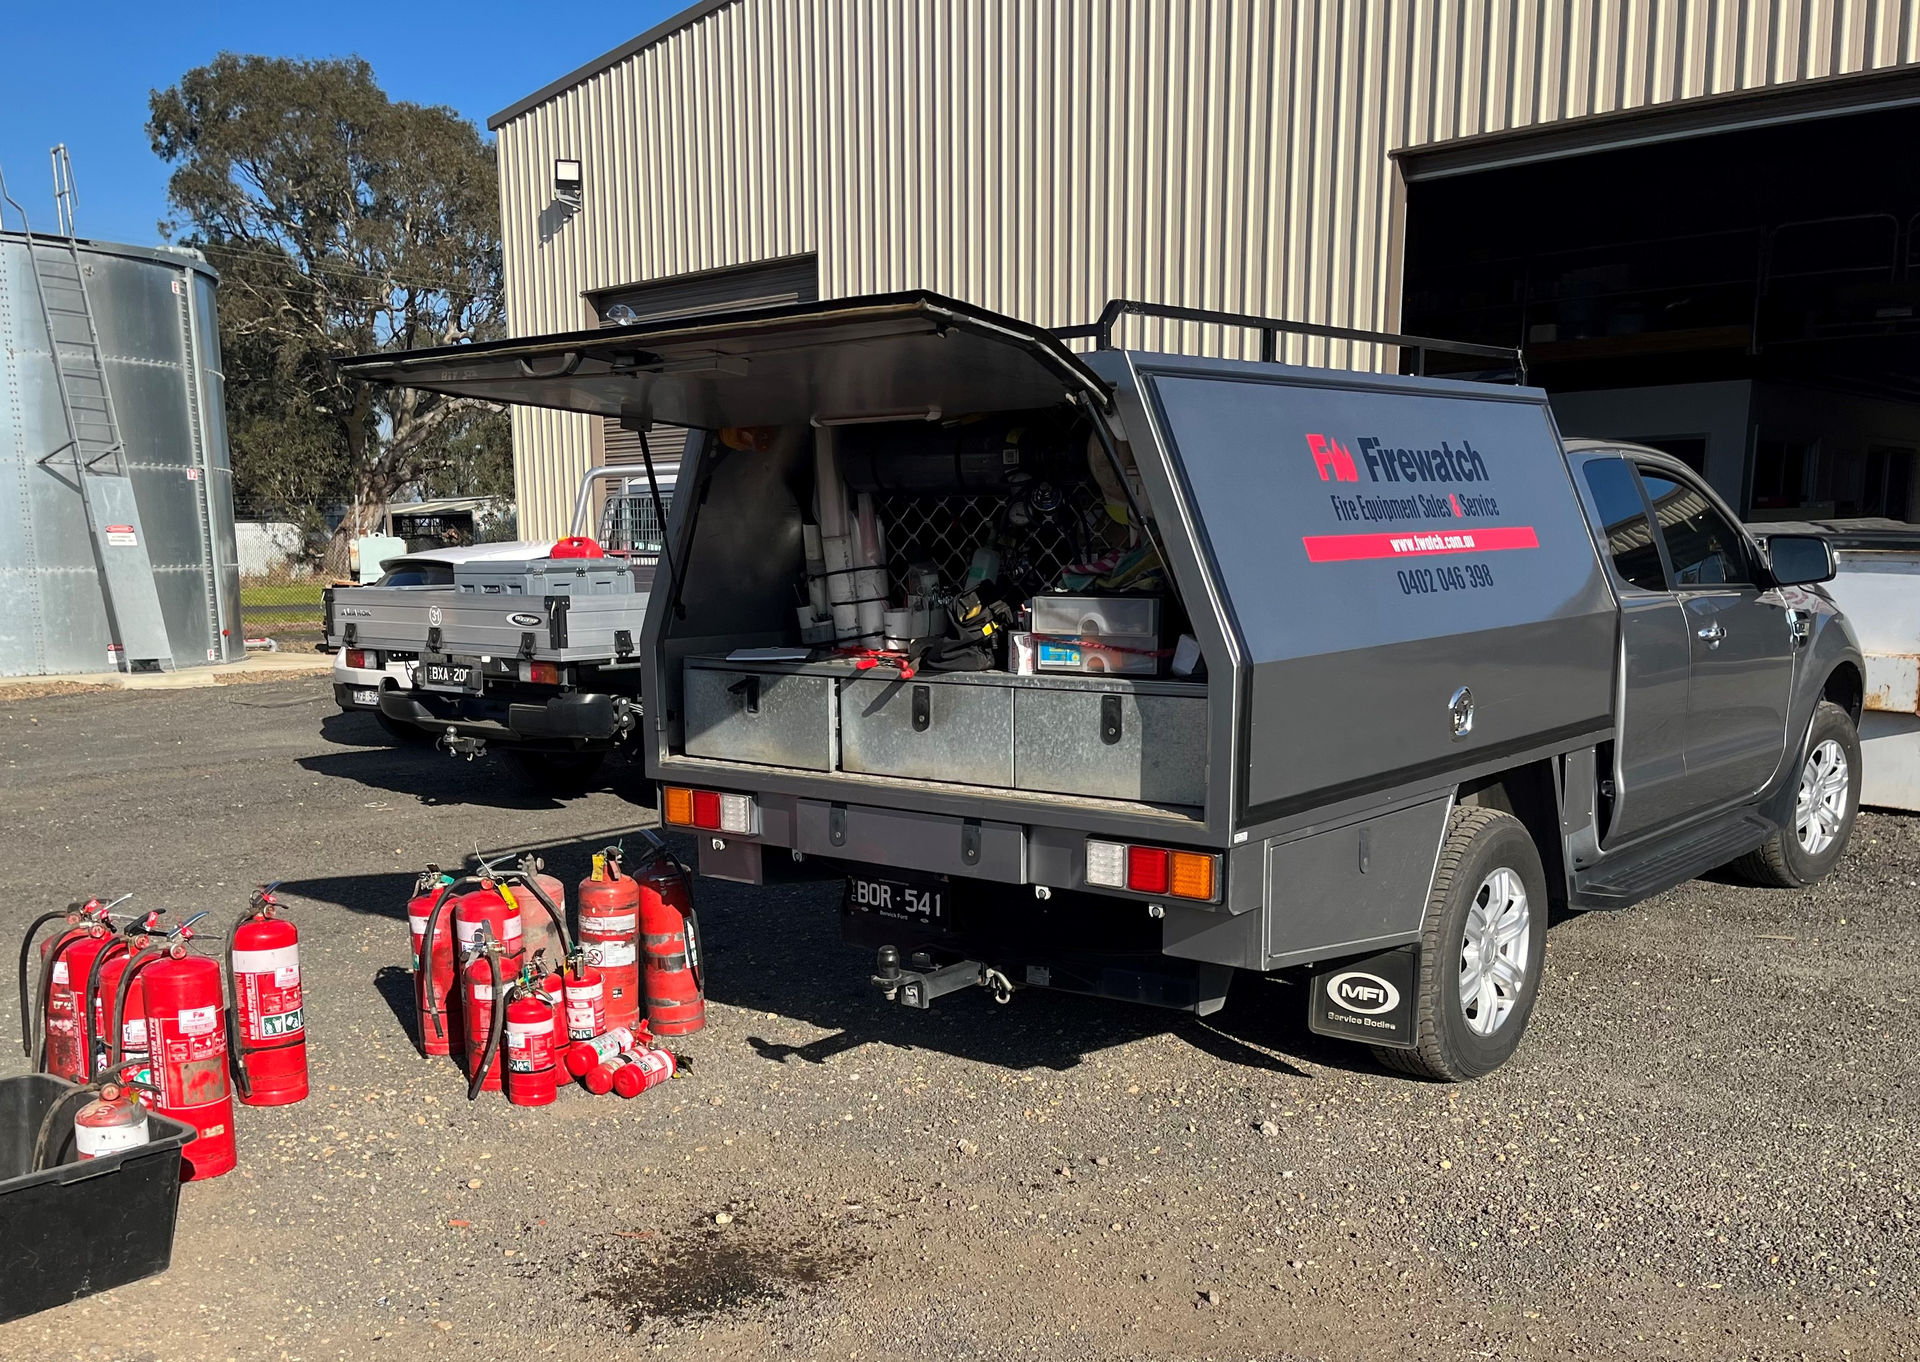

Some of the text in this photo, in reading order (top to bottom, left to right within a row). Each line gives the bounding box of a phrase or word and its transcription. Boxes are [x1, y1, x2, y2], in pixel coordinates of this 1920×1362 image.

[1357, 437, 1490, 482] Firewatch
[188, 469, 196, 479] 12
[1330, 493, 1500, 522] Fire Equipment Sales & Service
[1390, 534, 1475, 552] www.fwatch.com.au
[1397, 563, 1494, 595] 0402 046 398
[431, 609, 440, 622] 31
[1341, 983, 1385, 1003] MFI
[1327, 1011, 1396, 1030] Service Bodies
[151, 1040, 159, 1069] WATER
